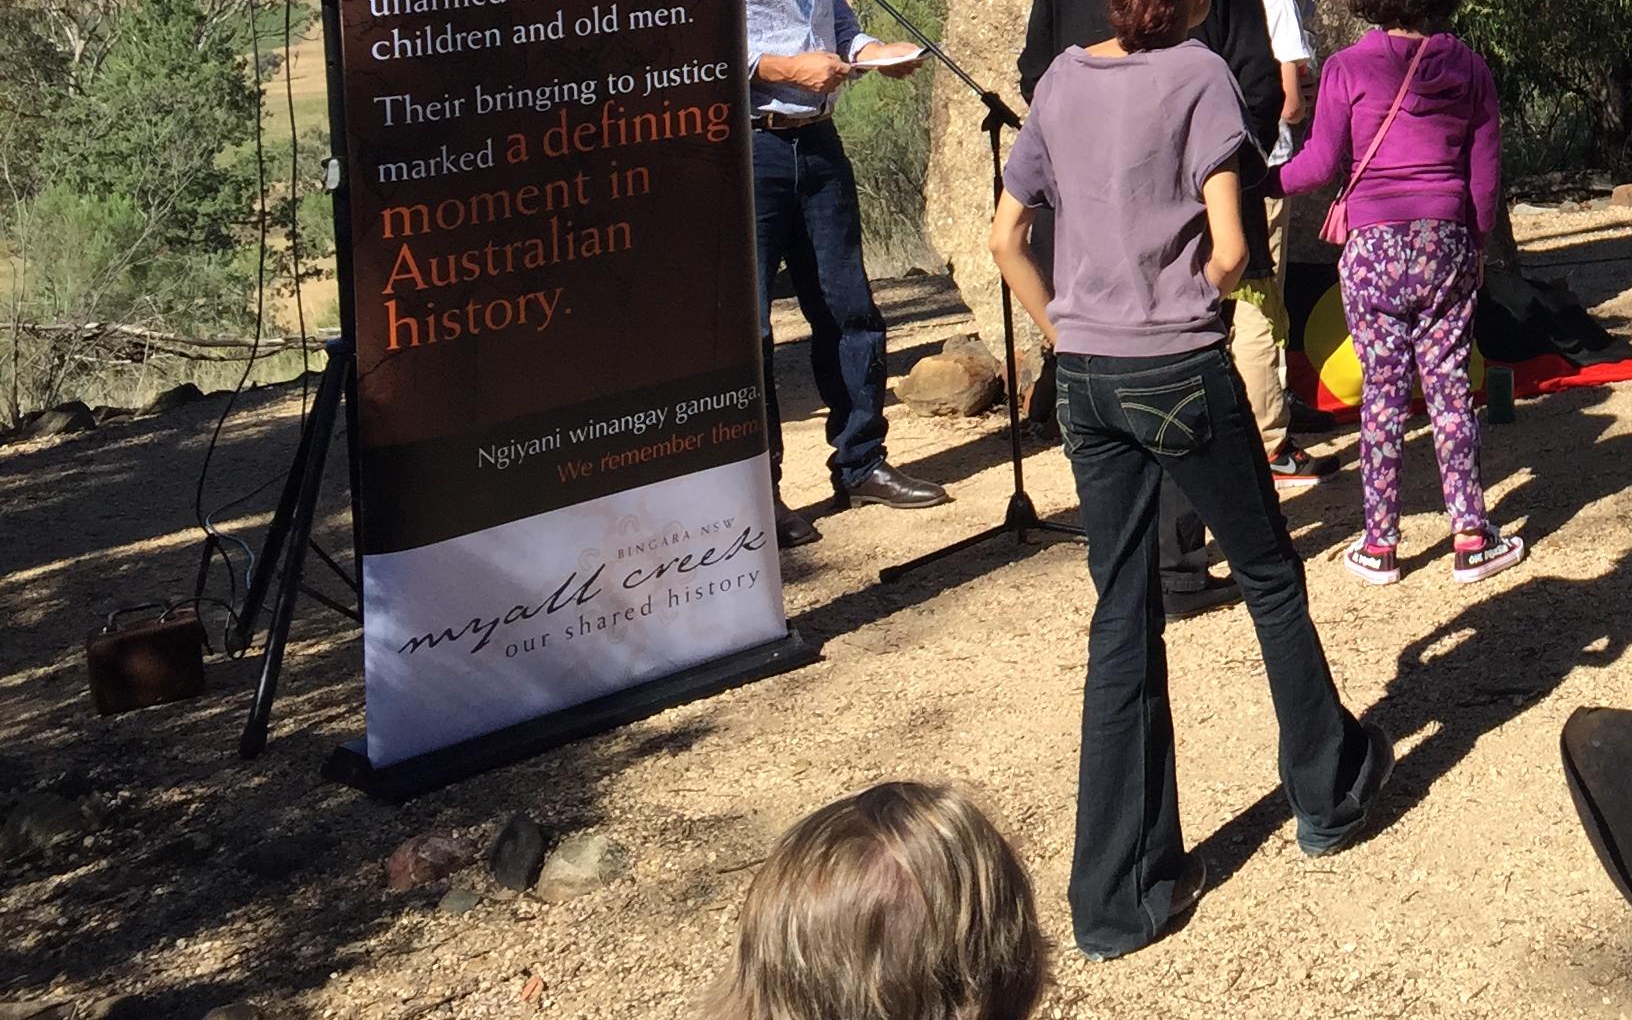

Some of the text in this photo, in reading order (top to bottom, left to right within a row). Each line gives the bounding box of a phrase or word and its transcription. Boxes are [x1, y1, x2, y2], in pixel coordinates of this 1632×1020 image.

[371, 5, 693, 60] children and old men.
[374, 61, 729, 127] Their bringing to justice
[379, 99, 731, 183] marked a defining
[381, 160, 650, 239] moment in
[382, 217, 632, 295] Australian
[385, 285, 571, 351] history.
[478, 428, 561, 469] Ngiyani
[569, 407, 668, 445] winangay
[557, 461, 593, 483] We
[600, 431, 703, 471] remember
[617, 517, 736, 560] BINGARA NSW
[398, 527, 767, 654] myall creek
[505, 568, 760, 659] our shared history
